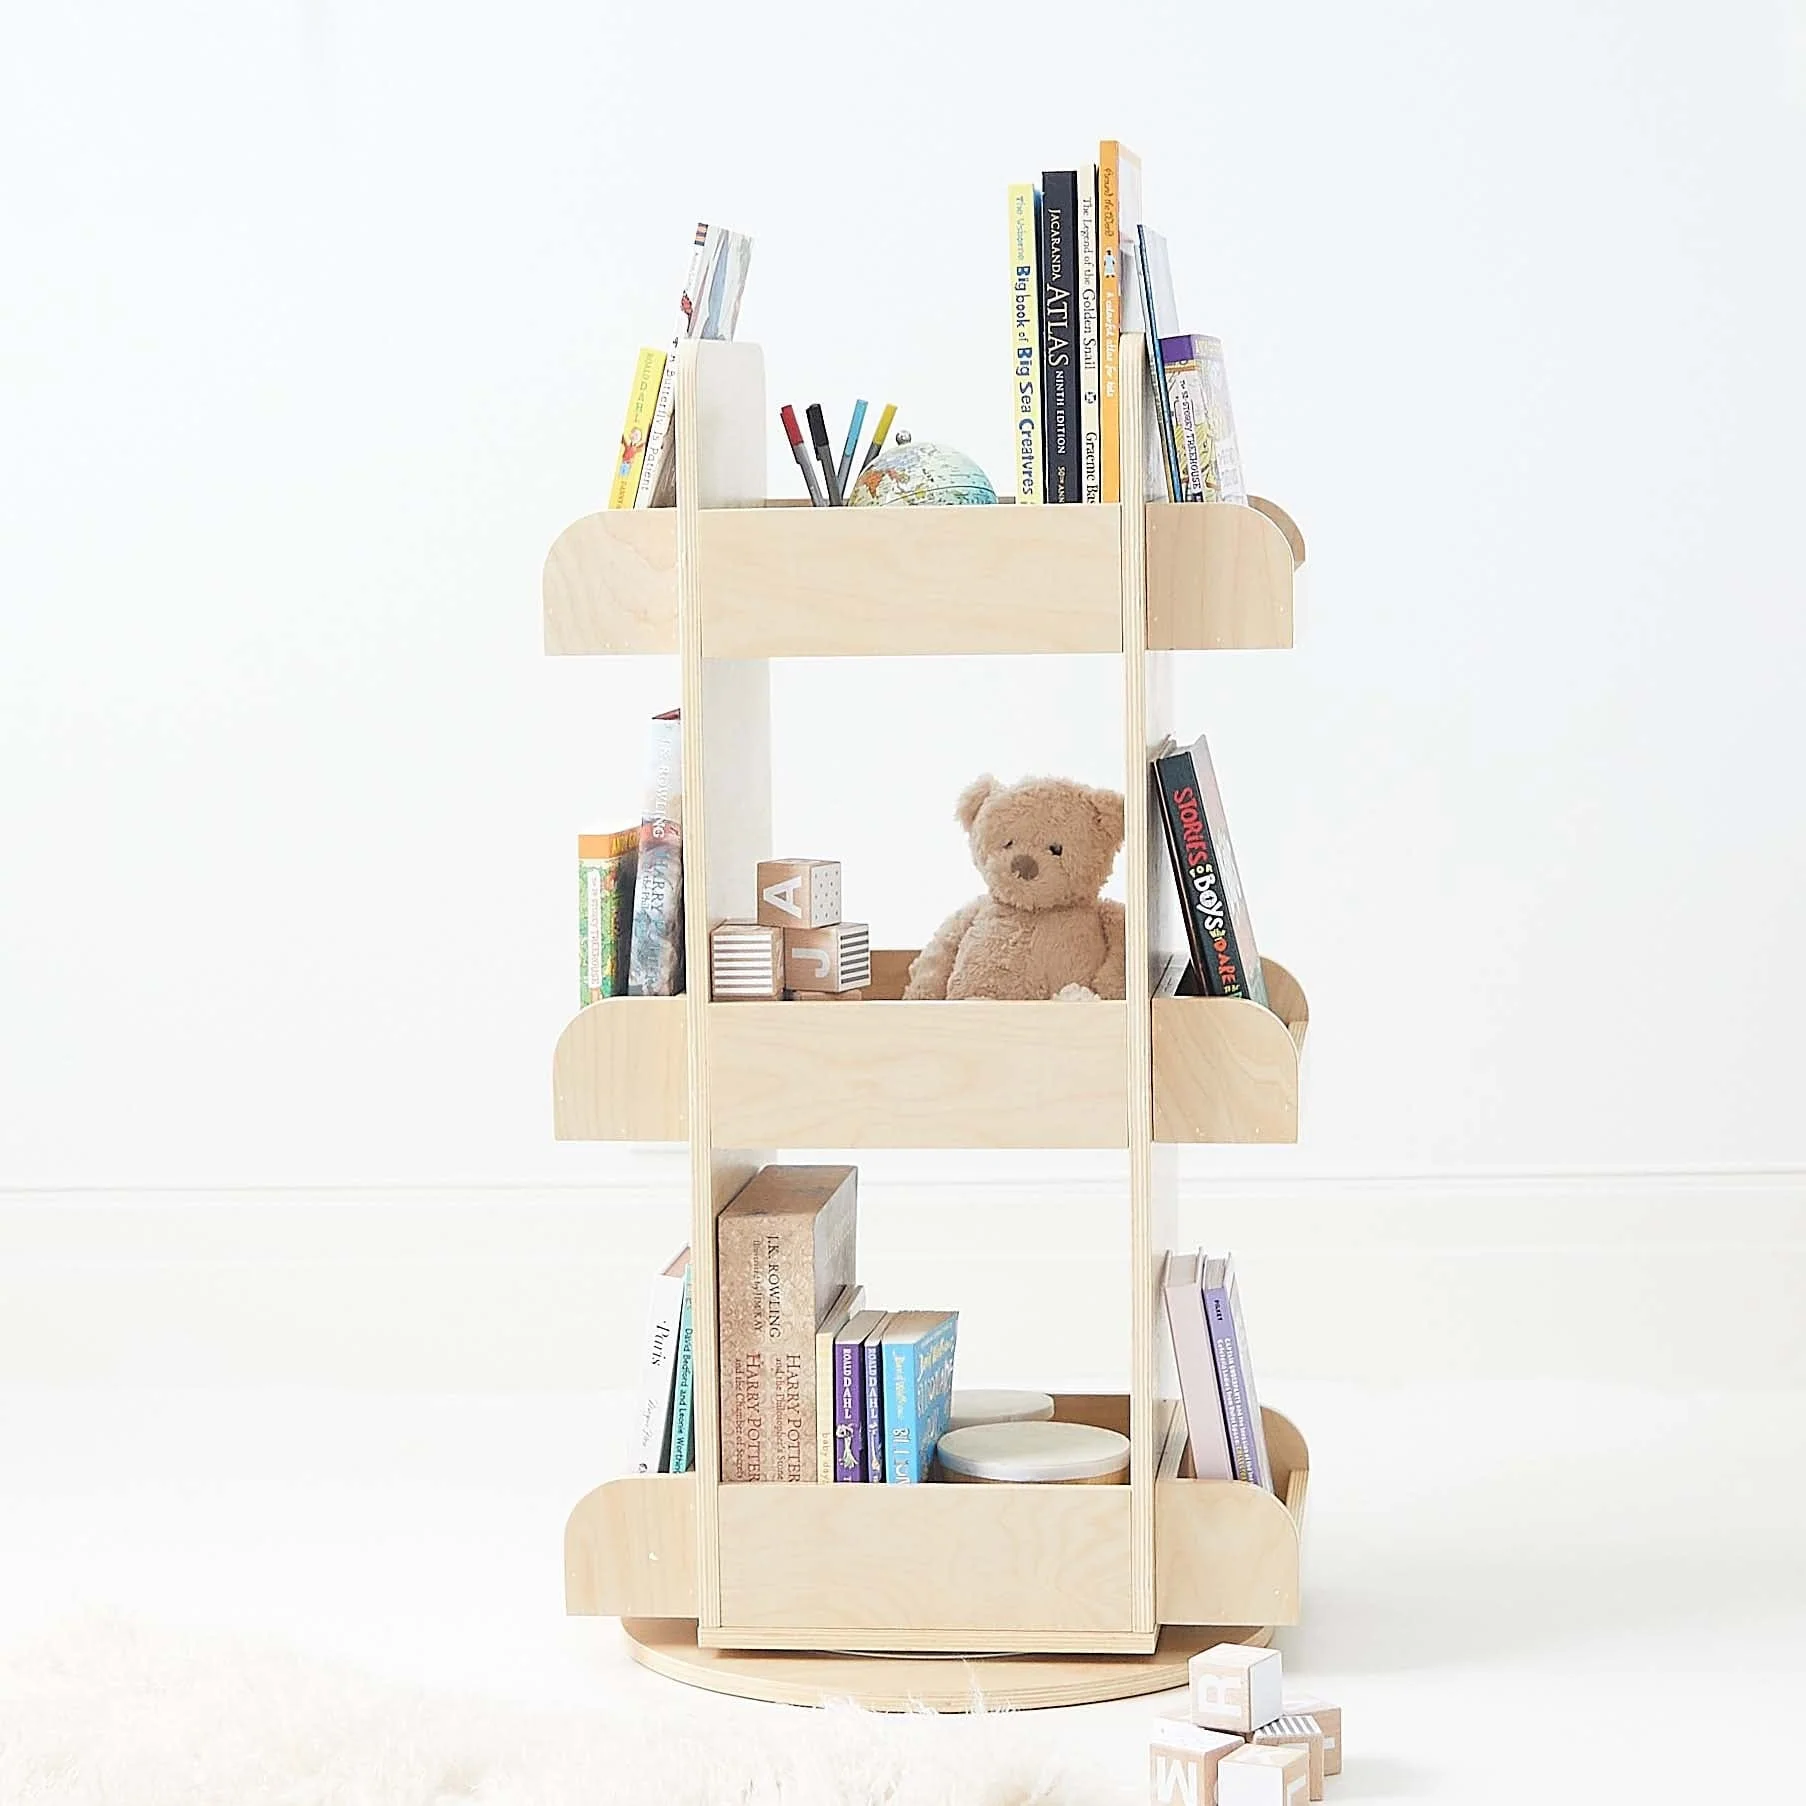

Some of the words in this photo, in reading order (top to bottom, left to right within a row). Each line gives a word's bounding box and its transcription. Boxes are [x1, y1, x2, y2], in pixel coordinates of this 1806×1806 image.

[1016, 196, 1024, 217] The
[1083, 197, 1092, 216] The
[1104, 199, 1113, 211] the
[1016, 218, 1025, 261] Usborne
[1048, 209, 1061, 281] JACARANDA
[1081, 219, 1092, 253] Legend
[1083, 256, 1093, 267] of
[1084, 269, 1093, 286] the
[1015, 266, 1030, 291] Big
[1016, 295, 1029, 328] book
[1046, 283, 1069, 366] ATLAS
[1083, 289, 1095, 334] Golden
[1105, 300, 1114, 338] colourful
[1018, 332, 1028, 342] of
[1106, 339, 1114, 362] atlas
[1016, 347, 1032, 376] Big
[1083, 338, 1096, 370] Snail
[1106, 365, 1114, 377] for
[653, 368, 676, 426] Butterfly
[1019, 382, 1033, 413] Sea
[1056, 370, 1065, 406] NINTH
[1106, 381, 1114, 398] kids
[652, 431, 662, 441] Is
[1056, 410, 1066, 454] EDITION
[640, 446, 659, 492] Patient
[1019, 418, 1035, 495] Creatures
[1085, 432, 1097, 480] Graeme
[1183, 432, 1204, 490] TREEHOUSE
[652, 766, 671, 838] ROWLING
[1174, 787, 1208, 866] STORIES
[651, 851, 671, 914] HARRY
[1189, 864, 1213, 878] FOR
[763, 874, 802, 919] A
[792, 947, 831, 978] J
[1213, 937, 1236, 985] DARE
[767, 1236, 780, 1259] J.K.
[768, 1264, 781, 1338] ROWLING
[754, 1312, 762, 1332] KAY
[651, 1325, 671, 1367] Paris
[682, 1328, 695, 1352] David
[679, 1354, 692, 1387] Bedford
[735, 1359, 744, 1373] and
[776, 1358, 785, 1374] and
[843, 1349, 851, 1376] ROALD
[868, 1348, 877, 1375] ROALD
[678, 1389, 688, 1406] and
[735, 1377, 744, 1391] the
[746, 1353, 760, 1413] HARRY
[776, 1377, 784, 1390] the
[787, 1355, 801, 1414] HARRY
[843, 1377, 851, 1419] DAHL
[869, 1377, 878, 1419] DAHL
[676, 1408, 687, 1434] Leonie
[774, 1394, 785, 1453] Philosopher's
[736, 1436, 744, 1445] of
[747, 1417, 762, 1483] POTTER
[787, 1418, 801, 1483] POTTER
[820, 1433, 830, 1456] baby
[777, 1455, 785, 1480] Stone
